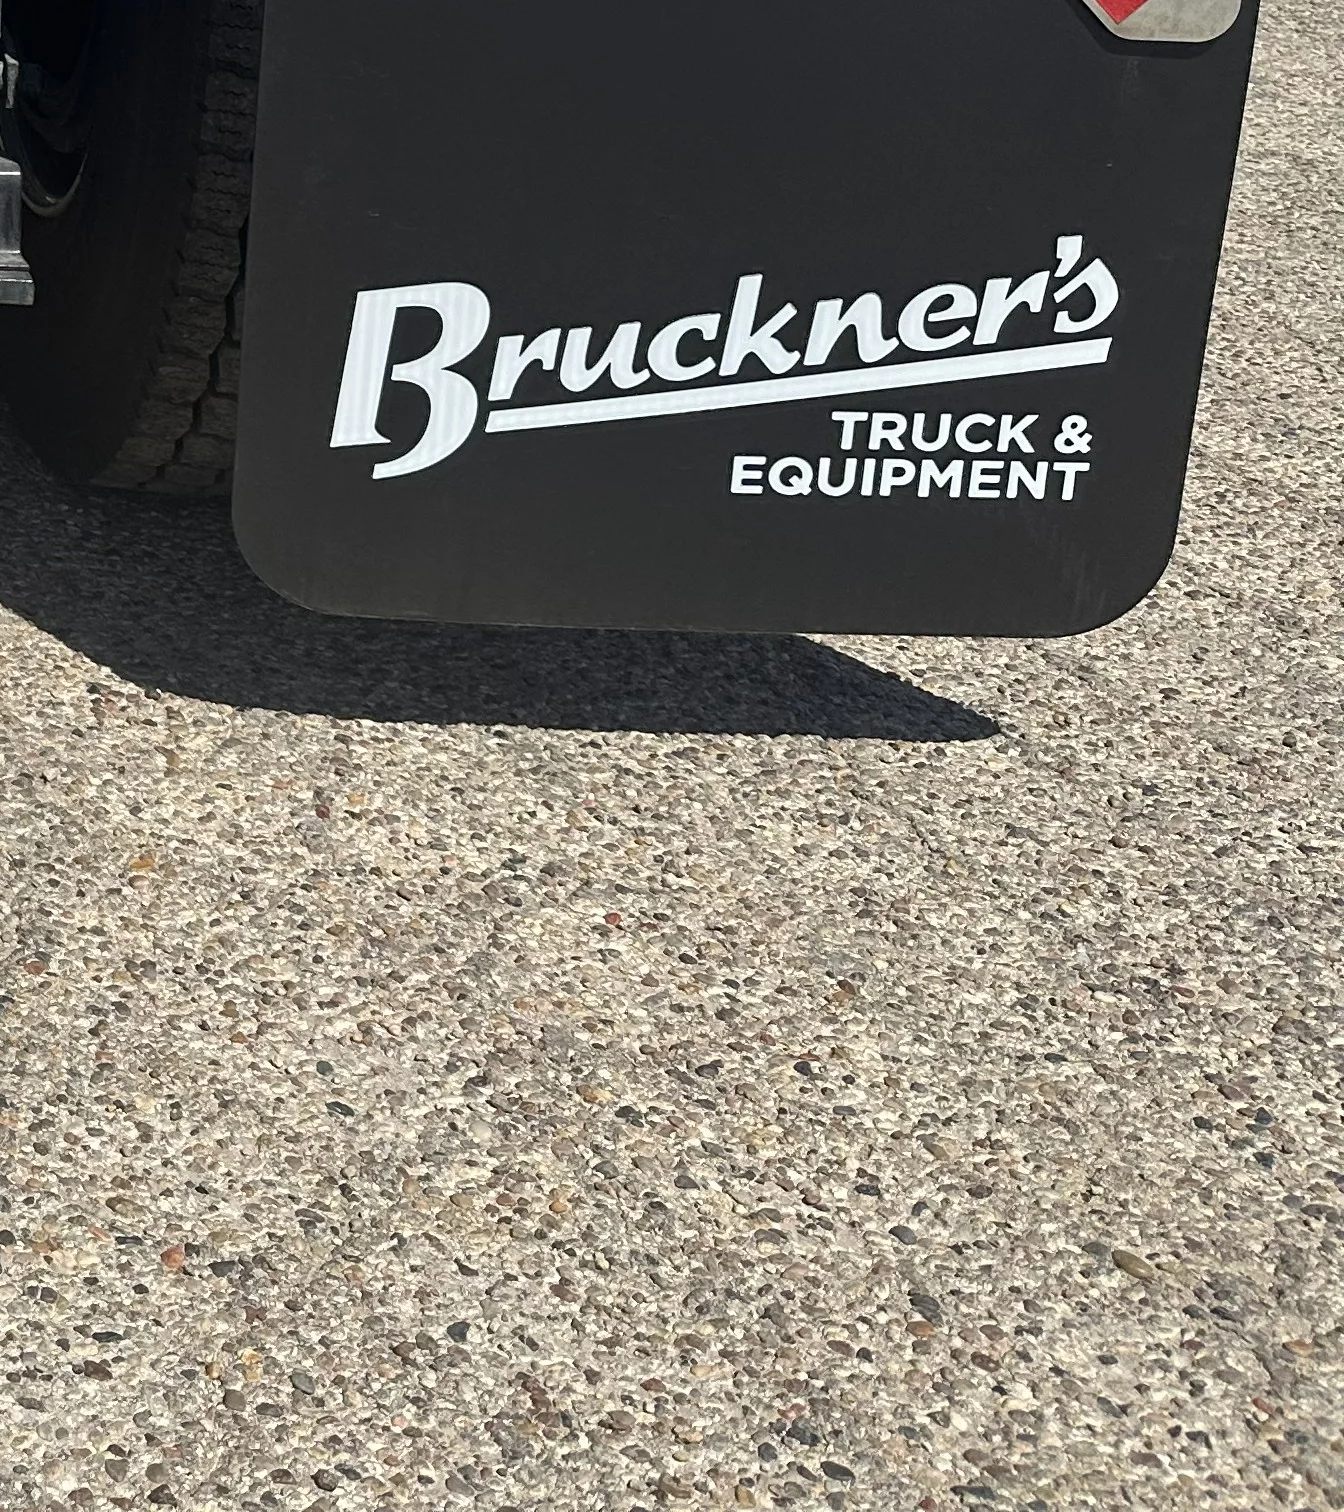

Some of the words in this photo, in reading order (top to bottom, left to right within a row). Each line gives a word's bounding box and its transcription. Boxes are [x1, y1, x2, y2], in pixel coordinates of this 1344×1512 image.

[329, 234, 1119, 480] Bruckner's
[831, 411, 1040, 454] TRUCK
[1053, 414, 1093, 454] &
[730, 455, 1091, 501] EQUIPMENT
